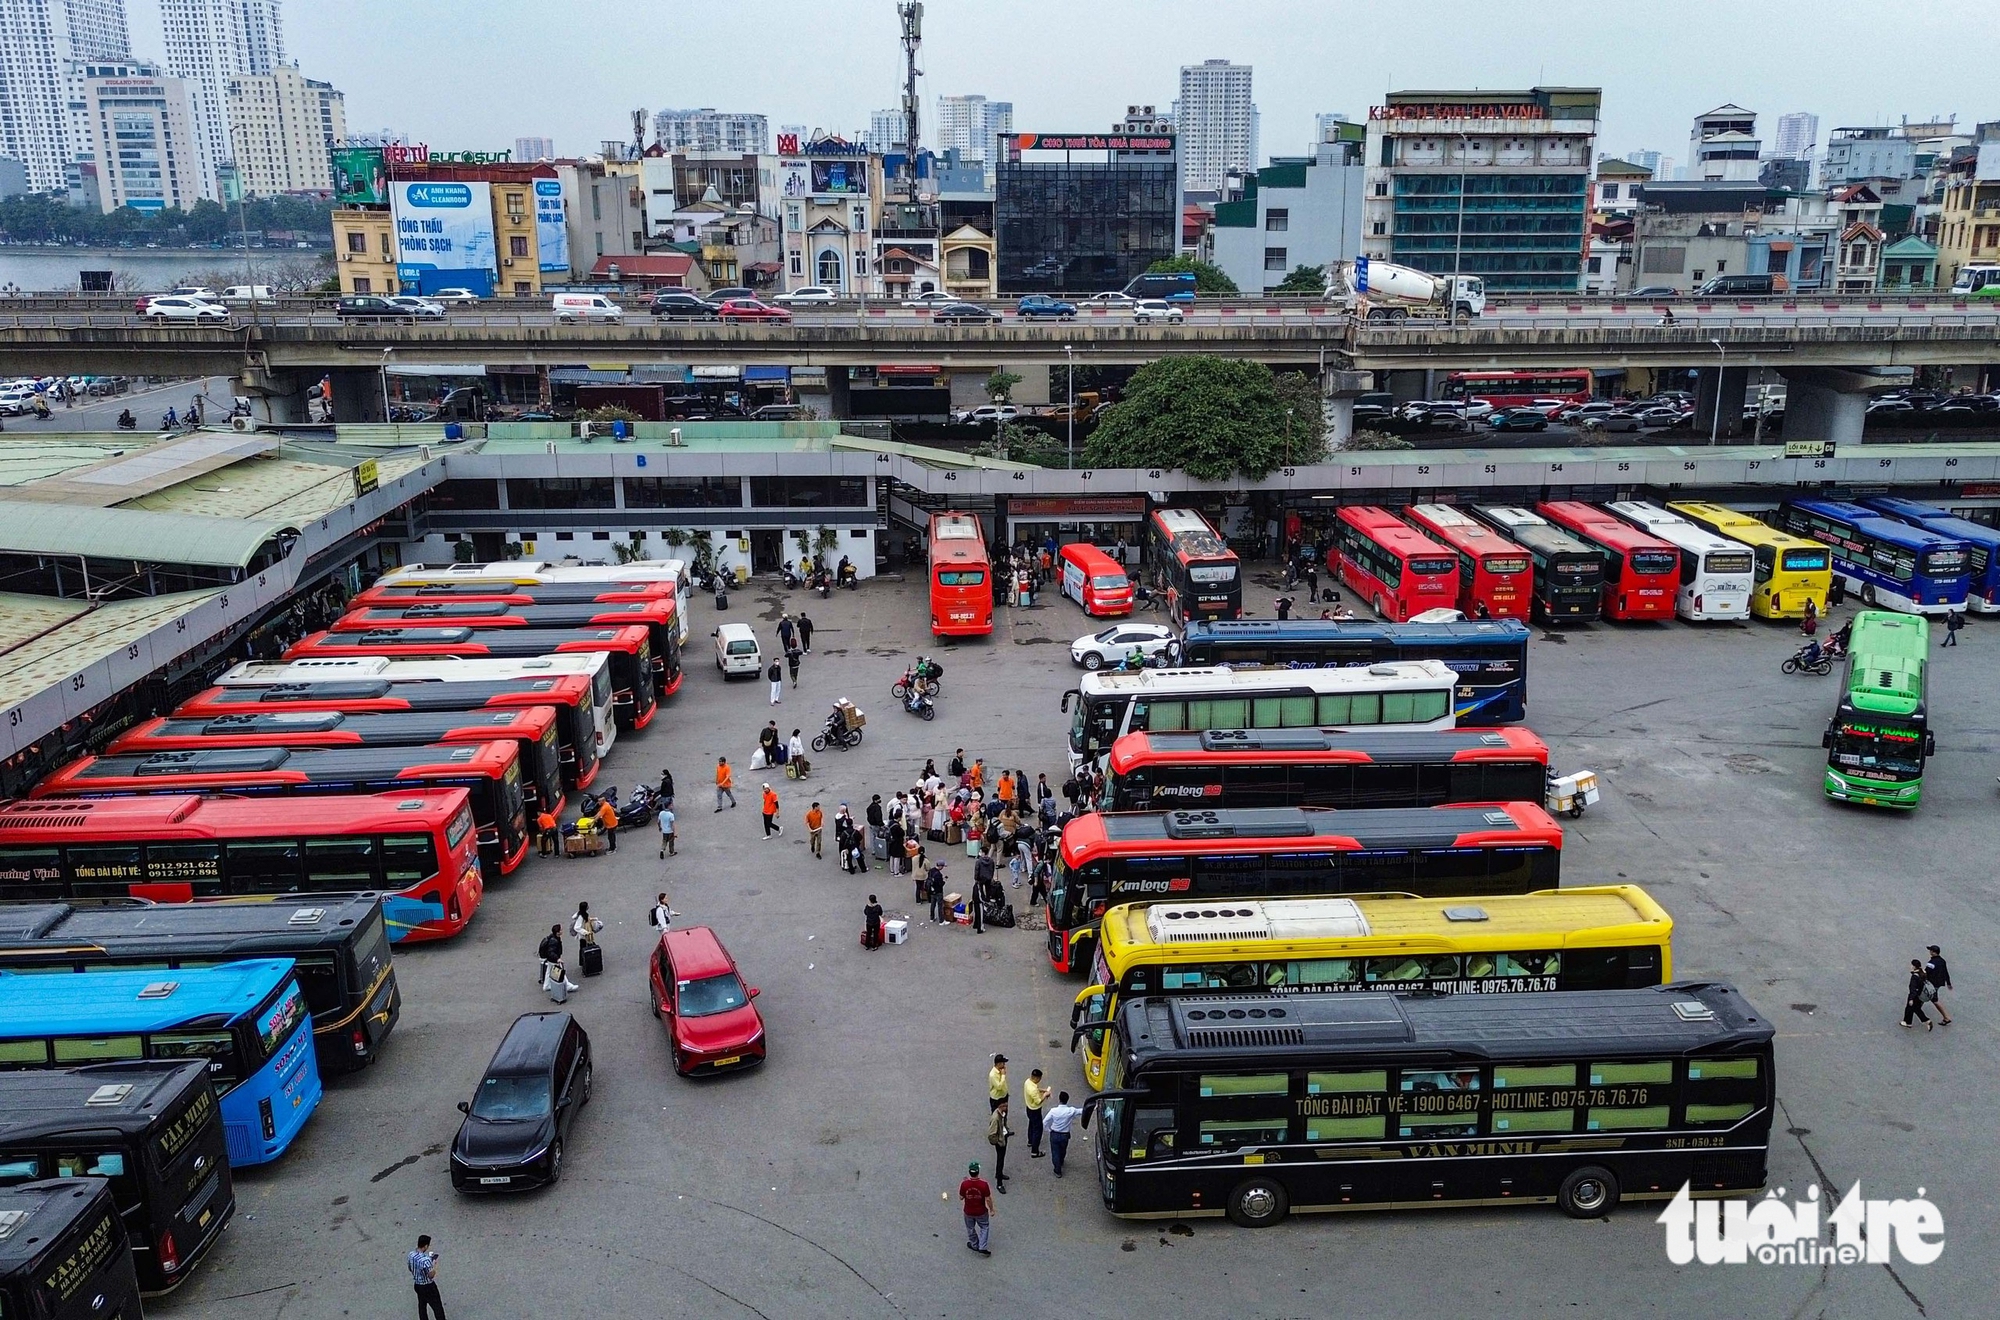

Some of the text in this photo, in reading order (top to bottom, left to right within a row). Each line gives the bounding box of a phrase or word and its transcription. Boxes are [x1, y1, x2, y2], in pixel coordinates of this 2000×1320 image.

[1500, 105, 1543, 120] VINH
[1041, 139, 1063, 148] CHO
[1129, 139, 1171, 149] BUILDING
[637, 455, 647, 467] B
[876, 454, 890, 464] 44
[1814, 459, 1826, 469] 58
[1879, 459, 1892, 468] 59
[1945, 458, 1958, 467] 60
[1484, 464, 1497, 474] 53
[1551, 463, 1563, 472] 54
[1618, 463, 1630, 472] 55
[1683, 461, 1696, 470] 56
[1749, 460, 1761, 469] 57
[1148, 470, 1161, 479] 48
[1283, 468, 1296, 477] 50
[1351, 466, 1362, 476] 51
[1417, 465, 1430, 475] 52
[944, 472, 957, 481] 45
[1012, 471, 1025, 481] 46
[1081, 471, 1093, 480] 47
[258, 574, 267, 588] 36
[219, 595, 229, 609] 35
[176, 618, 186, 633] 34
[128, 644, 139, 660] 33
[72, 673, 85, 692] 32
[10, 707, 23, 726] 31
[147, 861, 217, 870] 0912.921.622
[75, 864, 96, 878] TỔNG
[97, 866, 111, 877] ĐÀI
[111, 865, 127, 878] ĐẶT
[149, 869, 218, 877] 0912.797.898
[1481, 976, 1557, 995] 0975.76.76.76
[1296, 1088, 1648, 1117] TỔNG ĐÀI ĐẶT VÉ: 1900 6467 HOTLINE: 0975.76.76.76
[160, 1119, 184, 1152] VĂN
[184, 1090, 210, 1129] MINH
[1408, 1141, 1534, 1158] VĂN MINH
[46, 1215, 112, 1289] VĂN MINH
